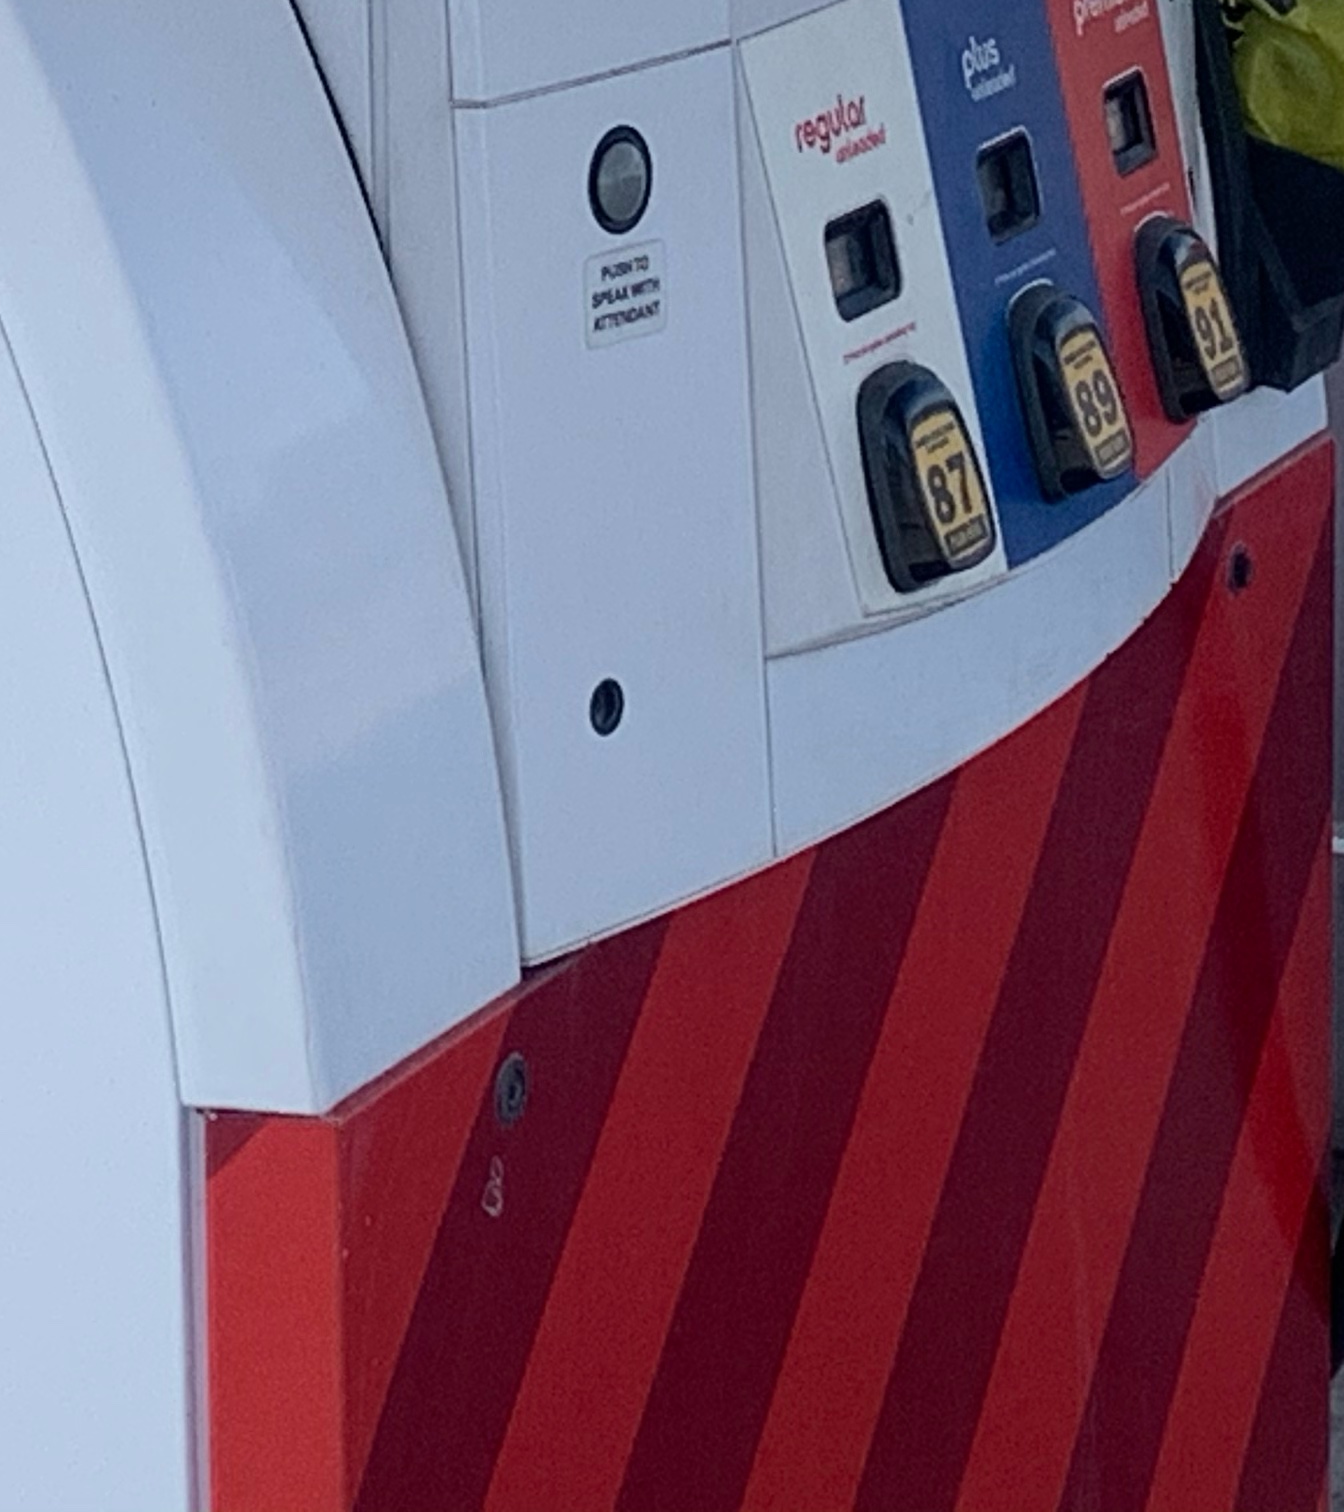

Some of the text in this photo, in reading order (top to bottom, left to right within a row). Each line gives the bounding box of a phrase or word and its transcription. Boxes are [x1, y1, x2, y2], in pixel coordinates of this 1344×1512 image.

[961, 35, 1001, 90] plus
[793, 93, 867, 155] regular
[591, 276, 661, 309] SPEAK WITH
[633, 255, 650, 272] TO
[592, 300, 661, 332] ATTENDANT
[1194, 297, 1234, 361] 91
[1074, 368, 1117, 438] 89
[927, 451, 973, 525] 87
